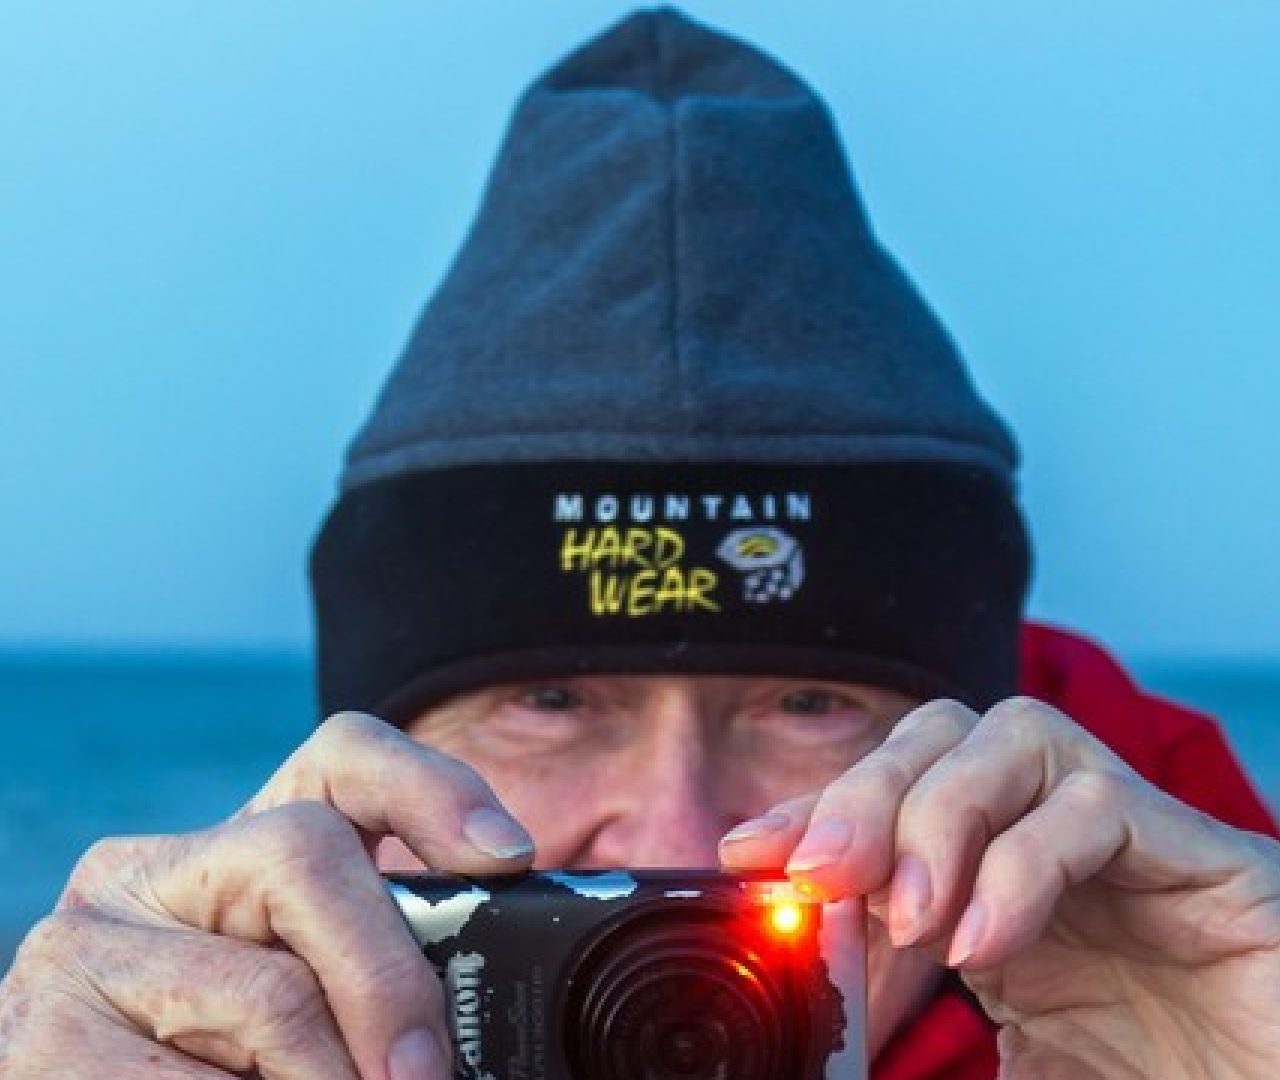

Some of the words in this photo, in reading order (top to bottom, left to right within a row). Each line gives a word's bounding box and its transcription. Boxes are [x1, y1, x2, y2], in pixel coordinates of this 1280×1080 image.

[553, 493, 811, 521] MOUNTAIN
[561, 526, 685, 571] HARD
[590, 567, 721, 616] WEAR
